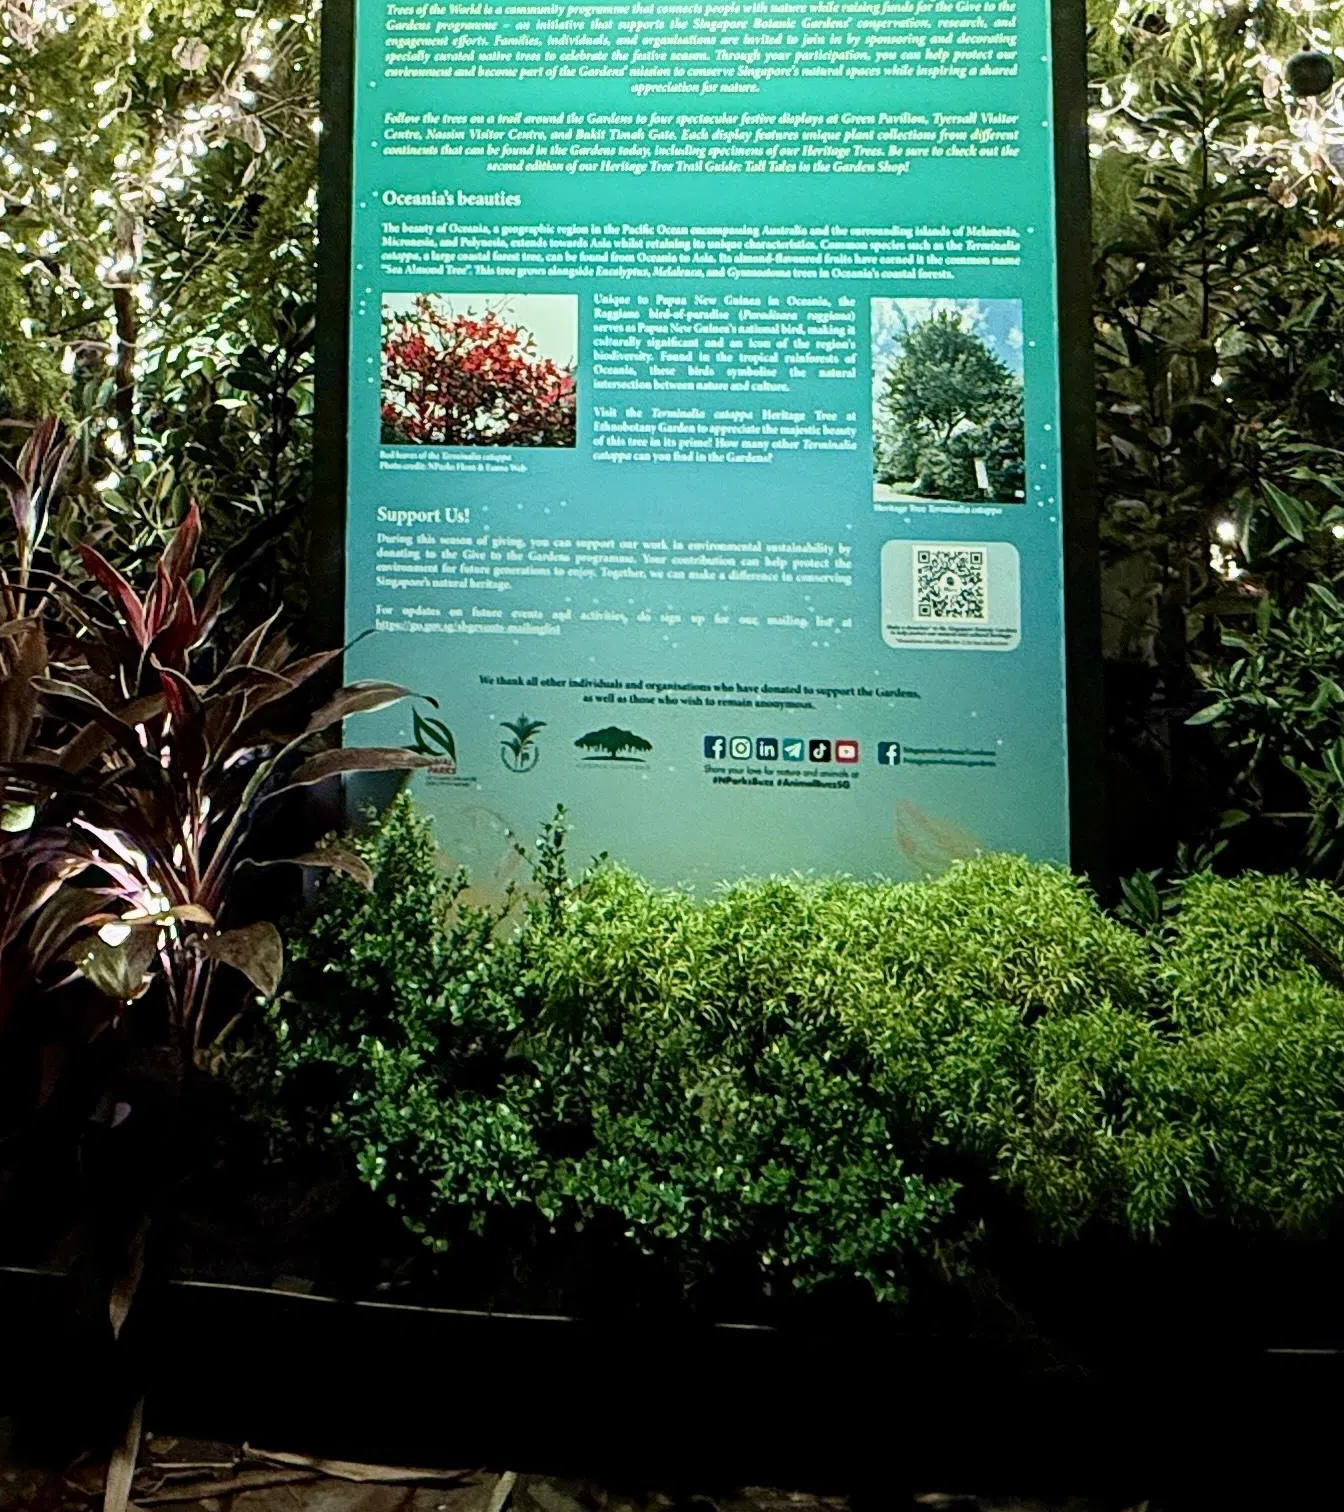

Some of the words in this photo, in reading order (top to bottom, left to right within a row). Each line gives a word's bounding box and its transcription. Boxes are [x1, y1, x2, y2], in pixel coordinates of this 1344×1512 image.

[386, 4, 413, 15] Trees
[416, 4, 426, 18] of
[429, 4, 446, 15] the
[448, 4, 481, 15] World
[484, 4, 492, 15] is
[495, 7, 502, 15] a
[505, 4, 564, 17] community
[567, 6, 629, 17] programme
[632, 3, 654, 14] that
[656, 4, 702, 14] connects
[705, 2, 740, 16] people
[743, 2, 767, 13] with
[770, 3, 806, 13] nature
[809, 2, 839, 13] while
[841, 2, 880, 15] raising
[882, 2, 913, 15] funds
[916, 1, 932, 15] for
[934, 1, 952, 12] the
[955, 1, 981, 12] Give
[983, 2, 995, 12] to
[998, 1, 1016, 12] the
[385, 20, 430, 31] Gardens
[436, 22, 497, 33] programme
[515, 22, 530, 30] an
[536, 19, 584, 30] initiative
[590, 19, 612, 30] that
[618, 20, 664, 32] supports
[670, 18, 687, 29] the
[693, 18, 747, 32] Singapore
[753, 18, 795, 29] Botanic
[937, 17, 987, 30] research,
[993, 16, 1016, 27] and
[384, 113, 419, 124] Follow
[422, 113, 439, 124] the
[442, 114, 467, 124] trees
[470, 116, 484, 124] on
[487, 116, 494, 124] a
[497, 113, 521, 124] trail
[524, 113, 564, 124] around
[566, 113, 583, 124] the
[586, 113, 632, 124] Gardens
[636, 114, 647, 124] to
[650, 113, 672, 126] four
[676, 113, 737, 126] spectacular
[740, 113, 775, 126] festive
[778, 113, 823, 126] displays
[826, 114, 838, 124] at
[841, 113, 875, 124] Green
[878, 113, 929, 126] Pavilion,
[932, 113, 977, 126] Tyersall
[980, 113, 1020, 124] Visitor
[486, 161, 523, 171] second
[525, 161, 563, 171] edition
[566, 161, 576, 174] of
[579, 163, 597, 172] our
[600, 161, 647, 174] Heritage
[650, 161, 673, 172] Tree
[676, 161, 702, 172] Trail
[744, 161, 766, 172] Tall
[768, 161, 796, 172] Tales
[798, 161, 810, 172] in
[812, 161, 830, 172] the
[832, 161, 875, 172] Garden
[877, 161, 910, 174] Shop!
[382, 192, 454, 206] Oceania's
[457, 192, 522, 206] beauties
[593, 379, 652, 389] intersection
[653, 380, 694, 390] between
[696, 382, 728, 390] nature
[730, 381, 749, 391] and
[377, 507, 440, 526] Support
[445, 507, 470, 523] Us!
[376, 533, 412, 545] During
[417, 534, 435, 544] this
[476, 535, 487, 545] of
[530, 539, 548, 549] you
[576, 539, 614, 550] support
[642, 539, 668, 549] work
[672, 540, 683, 550] in
[688, 541, 761, 551] environmental
[766, 543, 834, 555] sustainability
[838, 544, 852, 556] by
[478, 676, 494, 685] We
[496, 676, 524, 686] thank
[526, 677, 538, 686] all
[540, 678, 566, 687] other
[568, 679, 622, 688] individuals
[625, 680, 643, 690] and
[645, 681, 711, 693] organisations
[713, 683, 734, 692] who
[736, 684, 758, 693] have
[761, 684, 801, 694] donated
[803, 686, 814, 695] to
[816, 687, 854, 698] support
[857, 687, 872, 697] the
[875, 688, 922, 700] Gardens,
[595, 694, 614, 704] well
[629, 695, 655, 704] those
[657, 696, 678, 705] who
[680, 696, 702, 706] wish
[705, 698, 714, 706] to
[717, 697, 752, 706] remain
[754, 701, 816, 710] anonymous.
